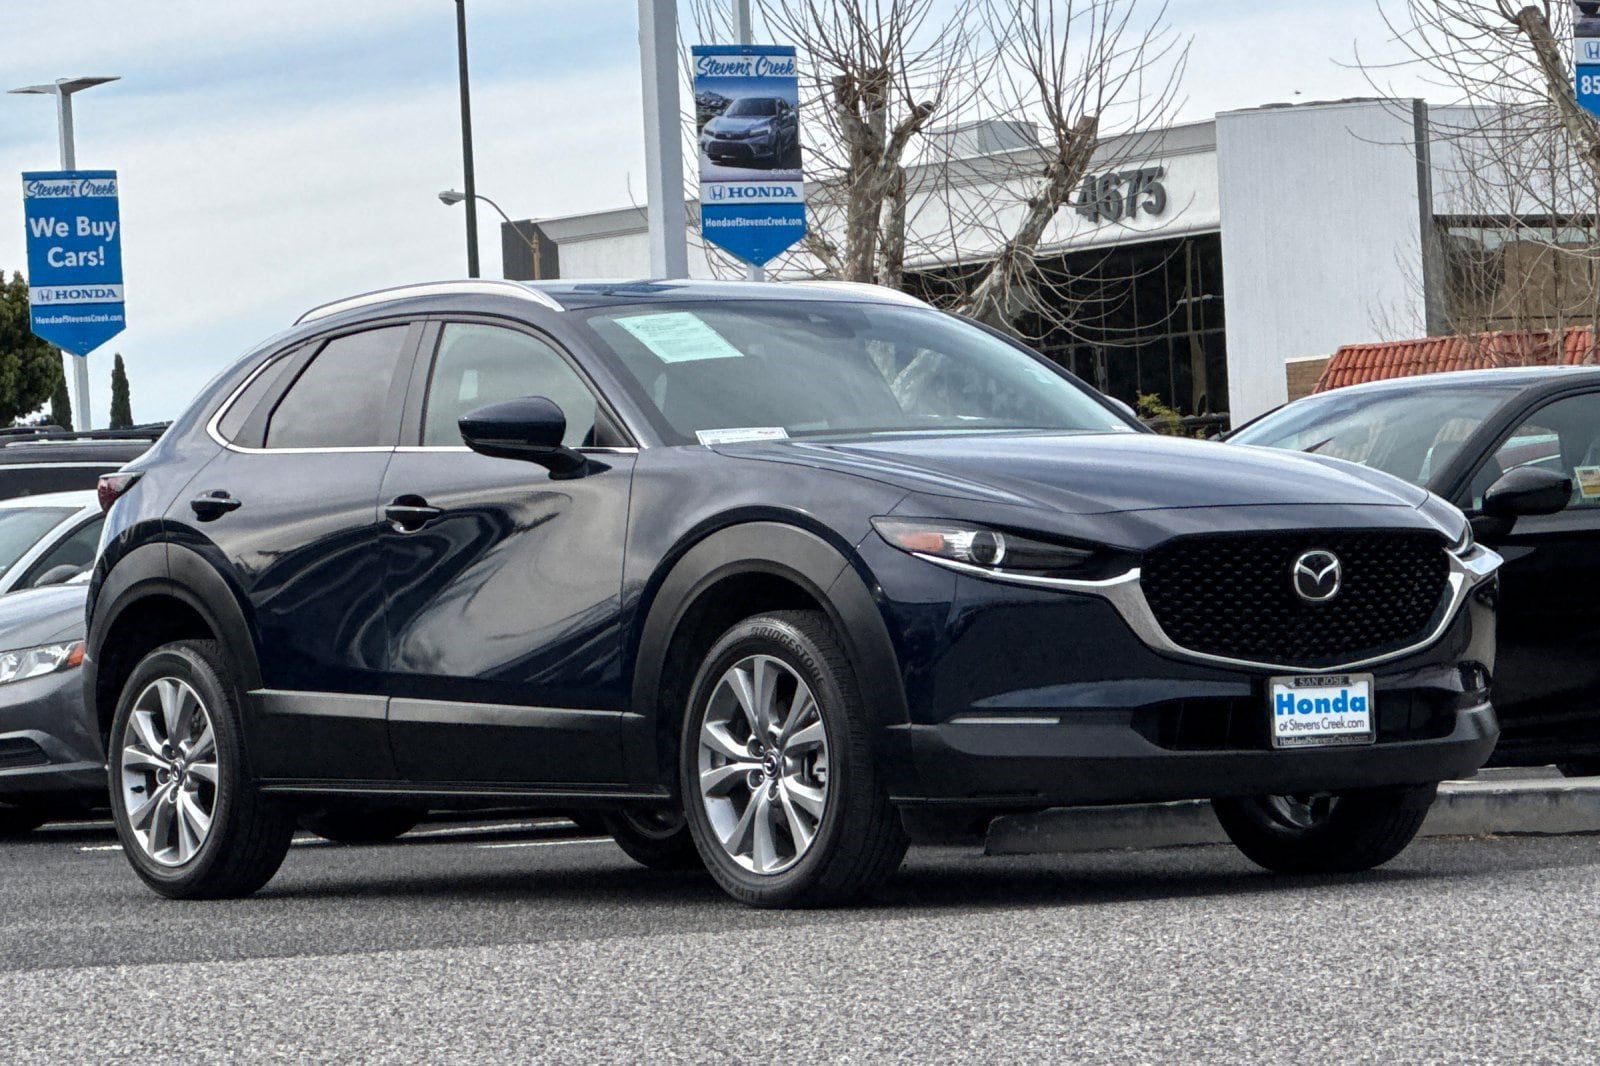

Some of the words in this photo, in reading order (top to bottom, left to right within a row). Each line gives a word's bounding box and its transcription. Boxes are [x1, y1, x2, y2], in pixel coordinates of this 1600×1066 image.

[755, 56, 795, 77] Creek
[79, 178, 116, 197] Creek
[728, 186, 797, 198] HONDA
[1076, 166, 1166, 223] 4675
[29, 217, 69, 238] We
[76, 216, 117, 242] Buy
[705, 216, 802, 228] HondaofStevensCreek.com
[47, 246, 105, 268] Cars!
[55, 288, 118, 300] HONDA
[1299, 678, 1319, 686] SAN
[1322, 676, 1345, 685] JOSE
[1276, 689, 1366, 715] Honda
[1279, 722, 1288, 732] of
[1289, 718, 1320, 731] Stevens
[1321, 715, 1365, 729] Creek.com
